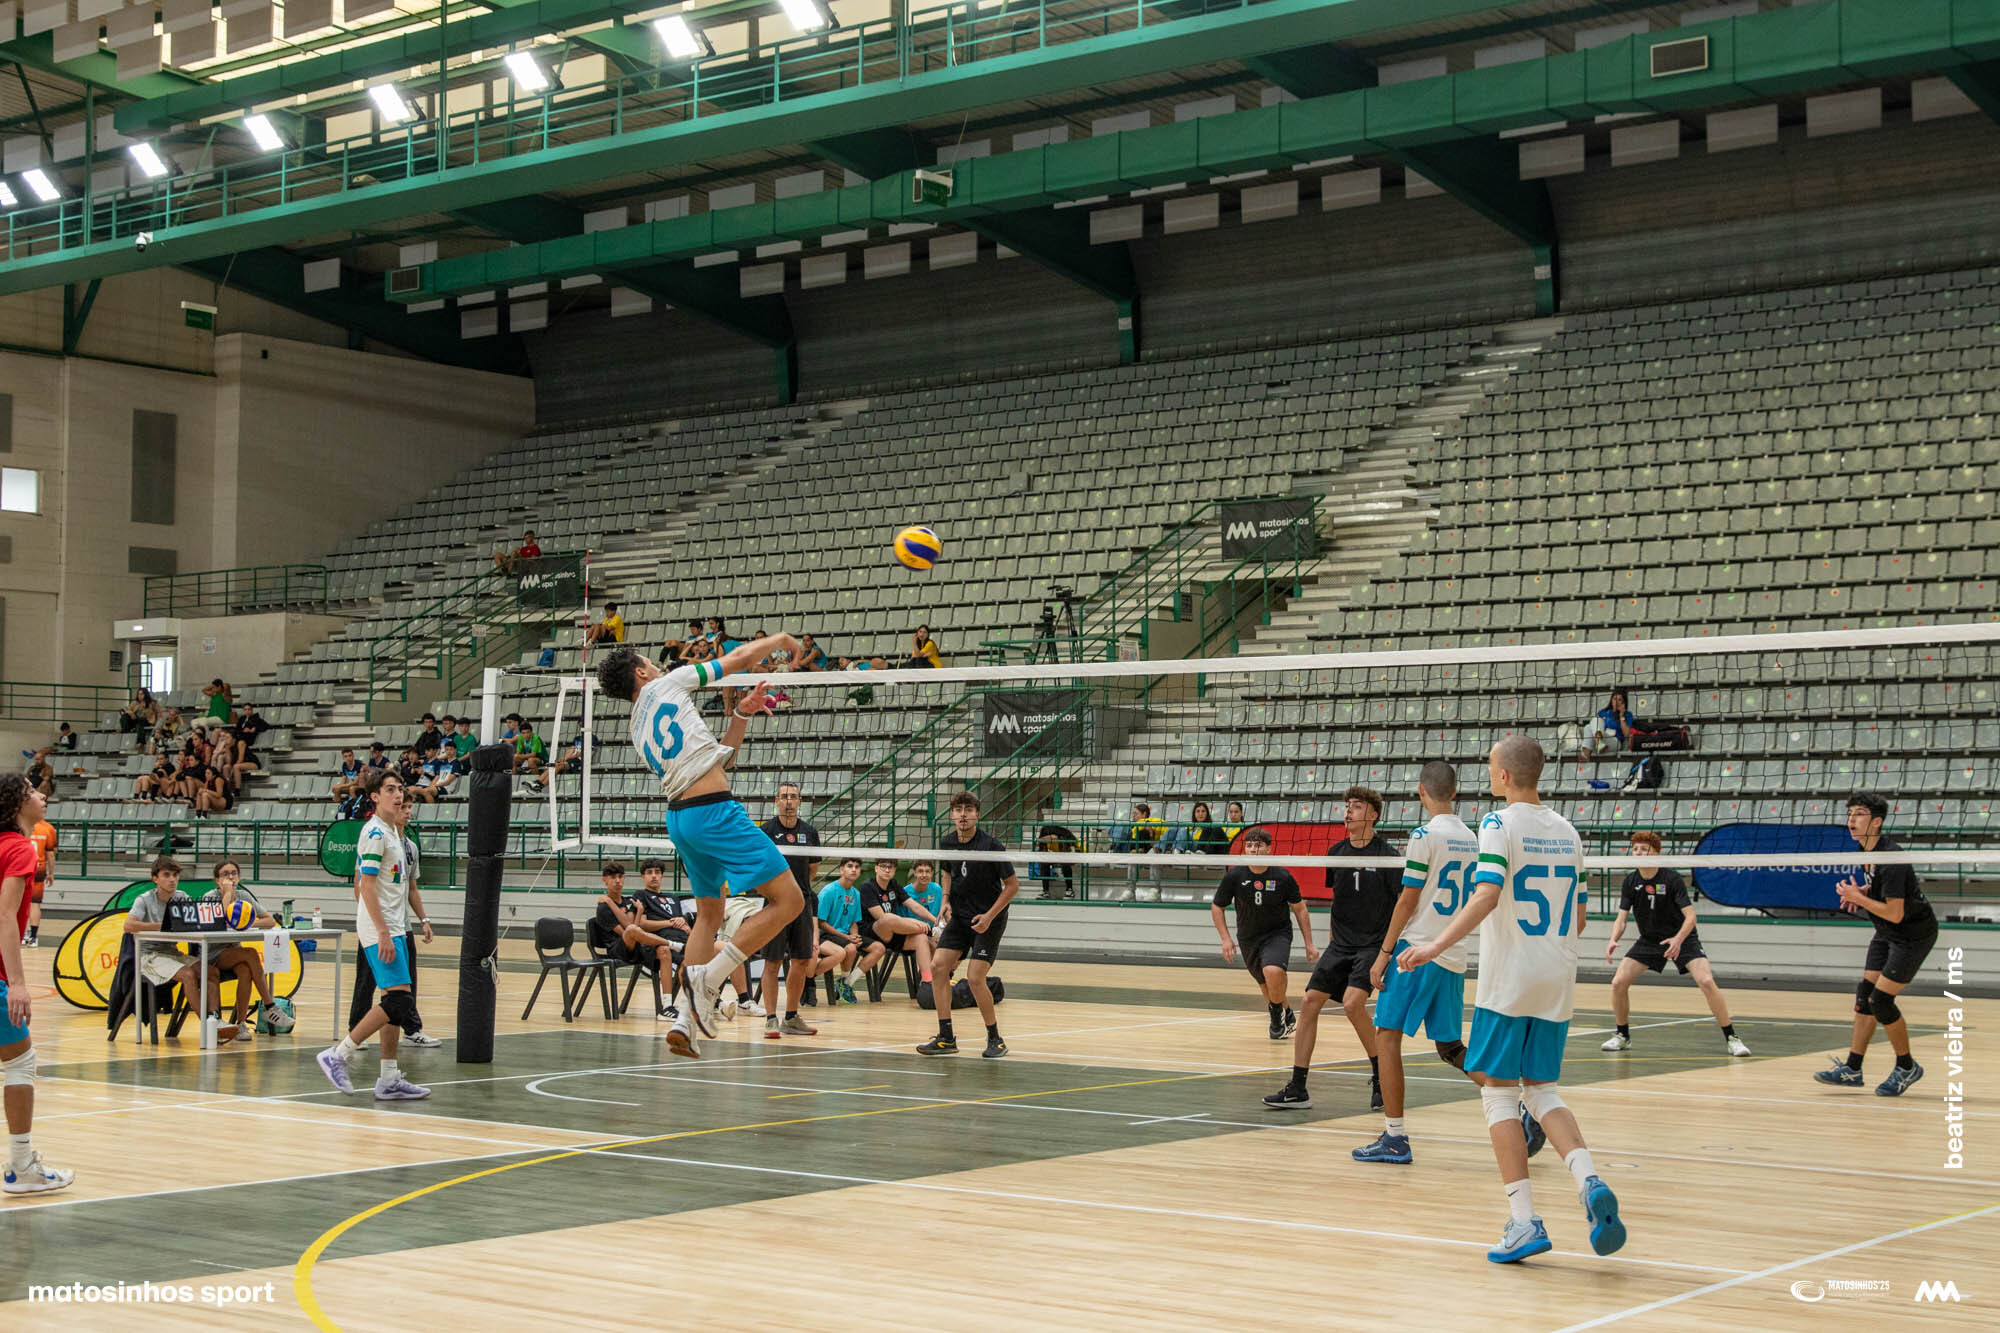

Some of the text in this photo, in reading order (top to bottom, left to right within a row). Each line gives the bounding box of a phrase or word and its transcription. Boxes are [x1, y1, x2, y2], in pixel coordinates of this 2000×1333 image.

[1259, 517, 1309, 528] matosinos
[961, 861, 967, 877] 6
[1353, 871, 1359, 891] 1
[1254, 891, 1262, 905] 8
[1513, 864, 1577, 936] 57
[1648, 895, 1655, 909] 7
[183, 906, 197, 922] 22
[200, 906, 211, 921] 17
[215, 905, 222, 916] 0
[273, 935, 280, 948] 4
